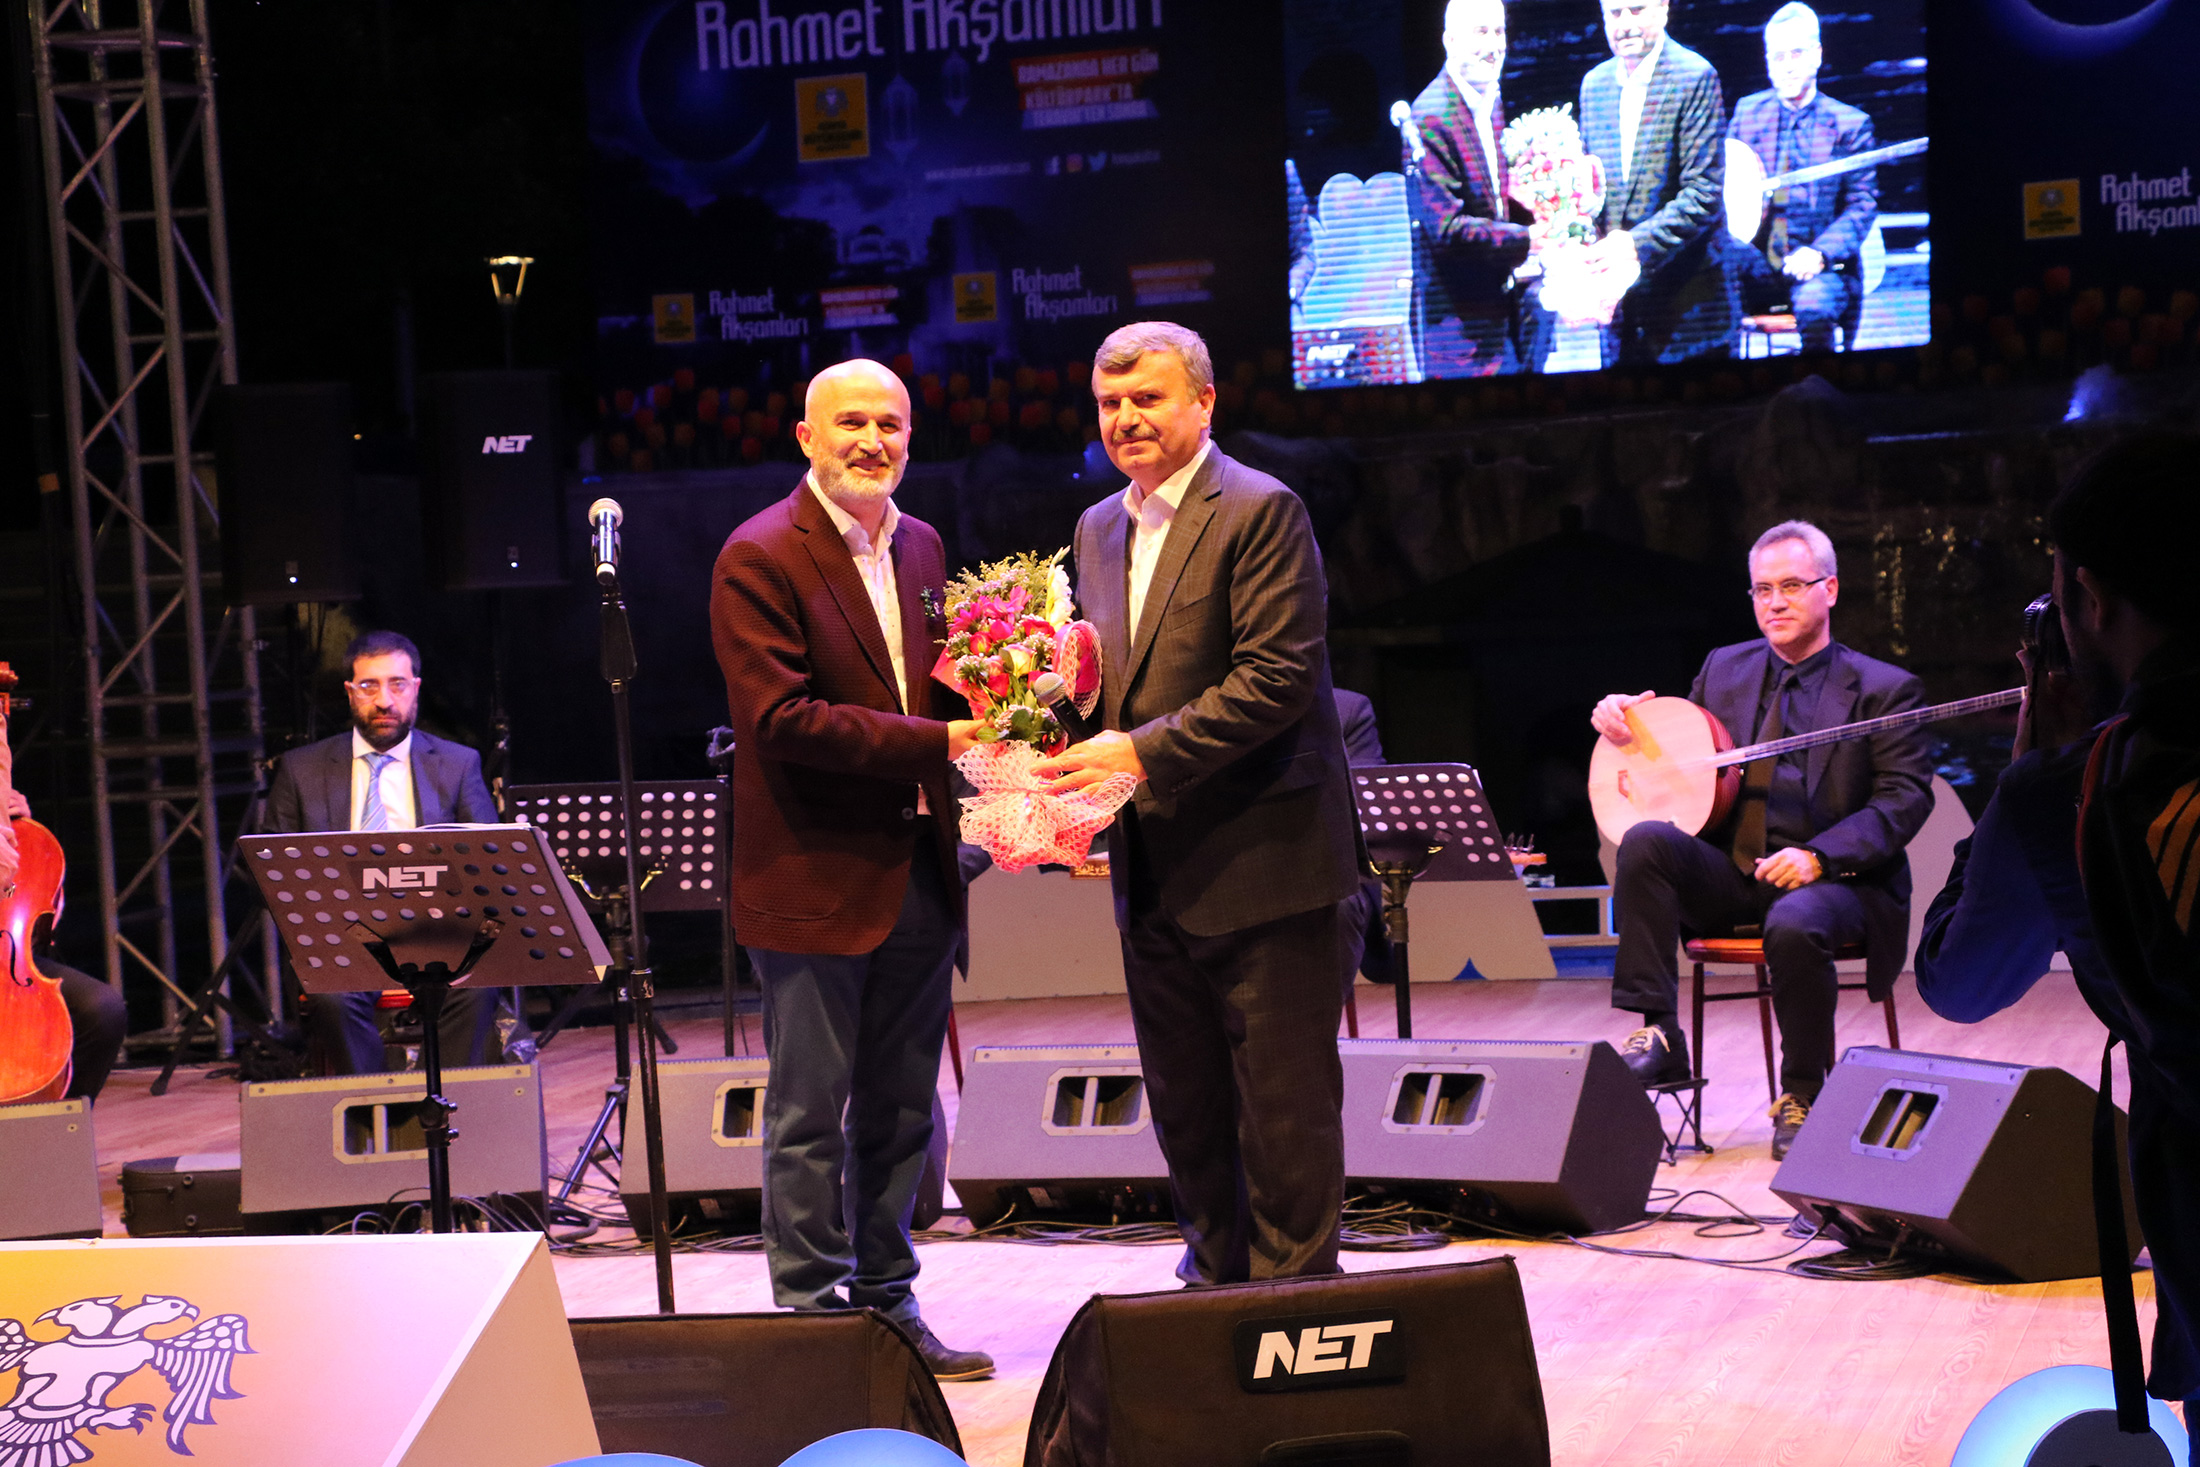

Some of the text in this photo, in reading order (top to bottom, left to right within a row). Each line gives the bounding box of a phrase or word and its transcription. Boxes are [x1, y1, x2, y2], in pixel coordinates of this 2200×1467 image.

[694, 0, 886, 71] Rahmet
[2100, 166, 2193, 206] Rahmet
[1011, 263, 1083, 295] Rahmet
[708, 286, 775, 317] Rahmet
[1024, 288, 1119, 324] Akşamları
[720, 311, 810, 344] Akşamları
[1306, 344, 1356, 362] NET
[481, 434, 533, 454] NET
[362, 865, 449, 890] NET
[1252, 1319, 1394, 1380] NET
